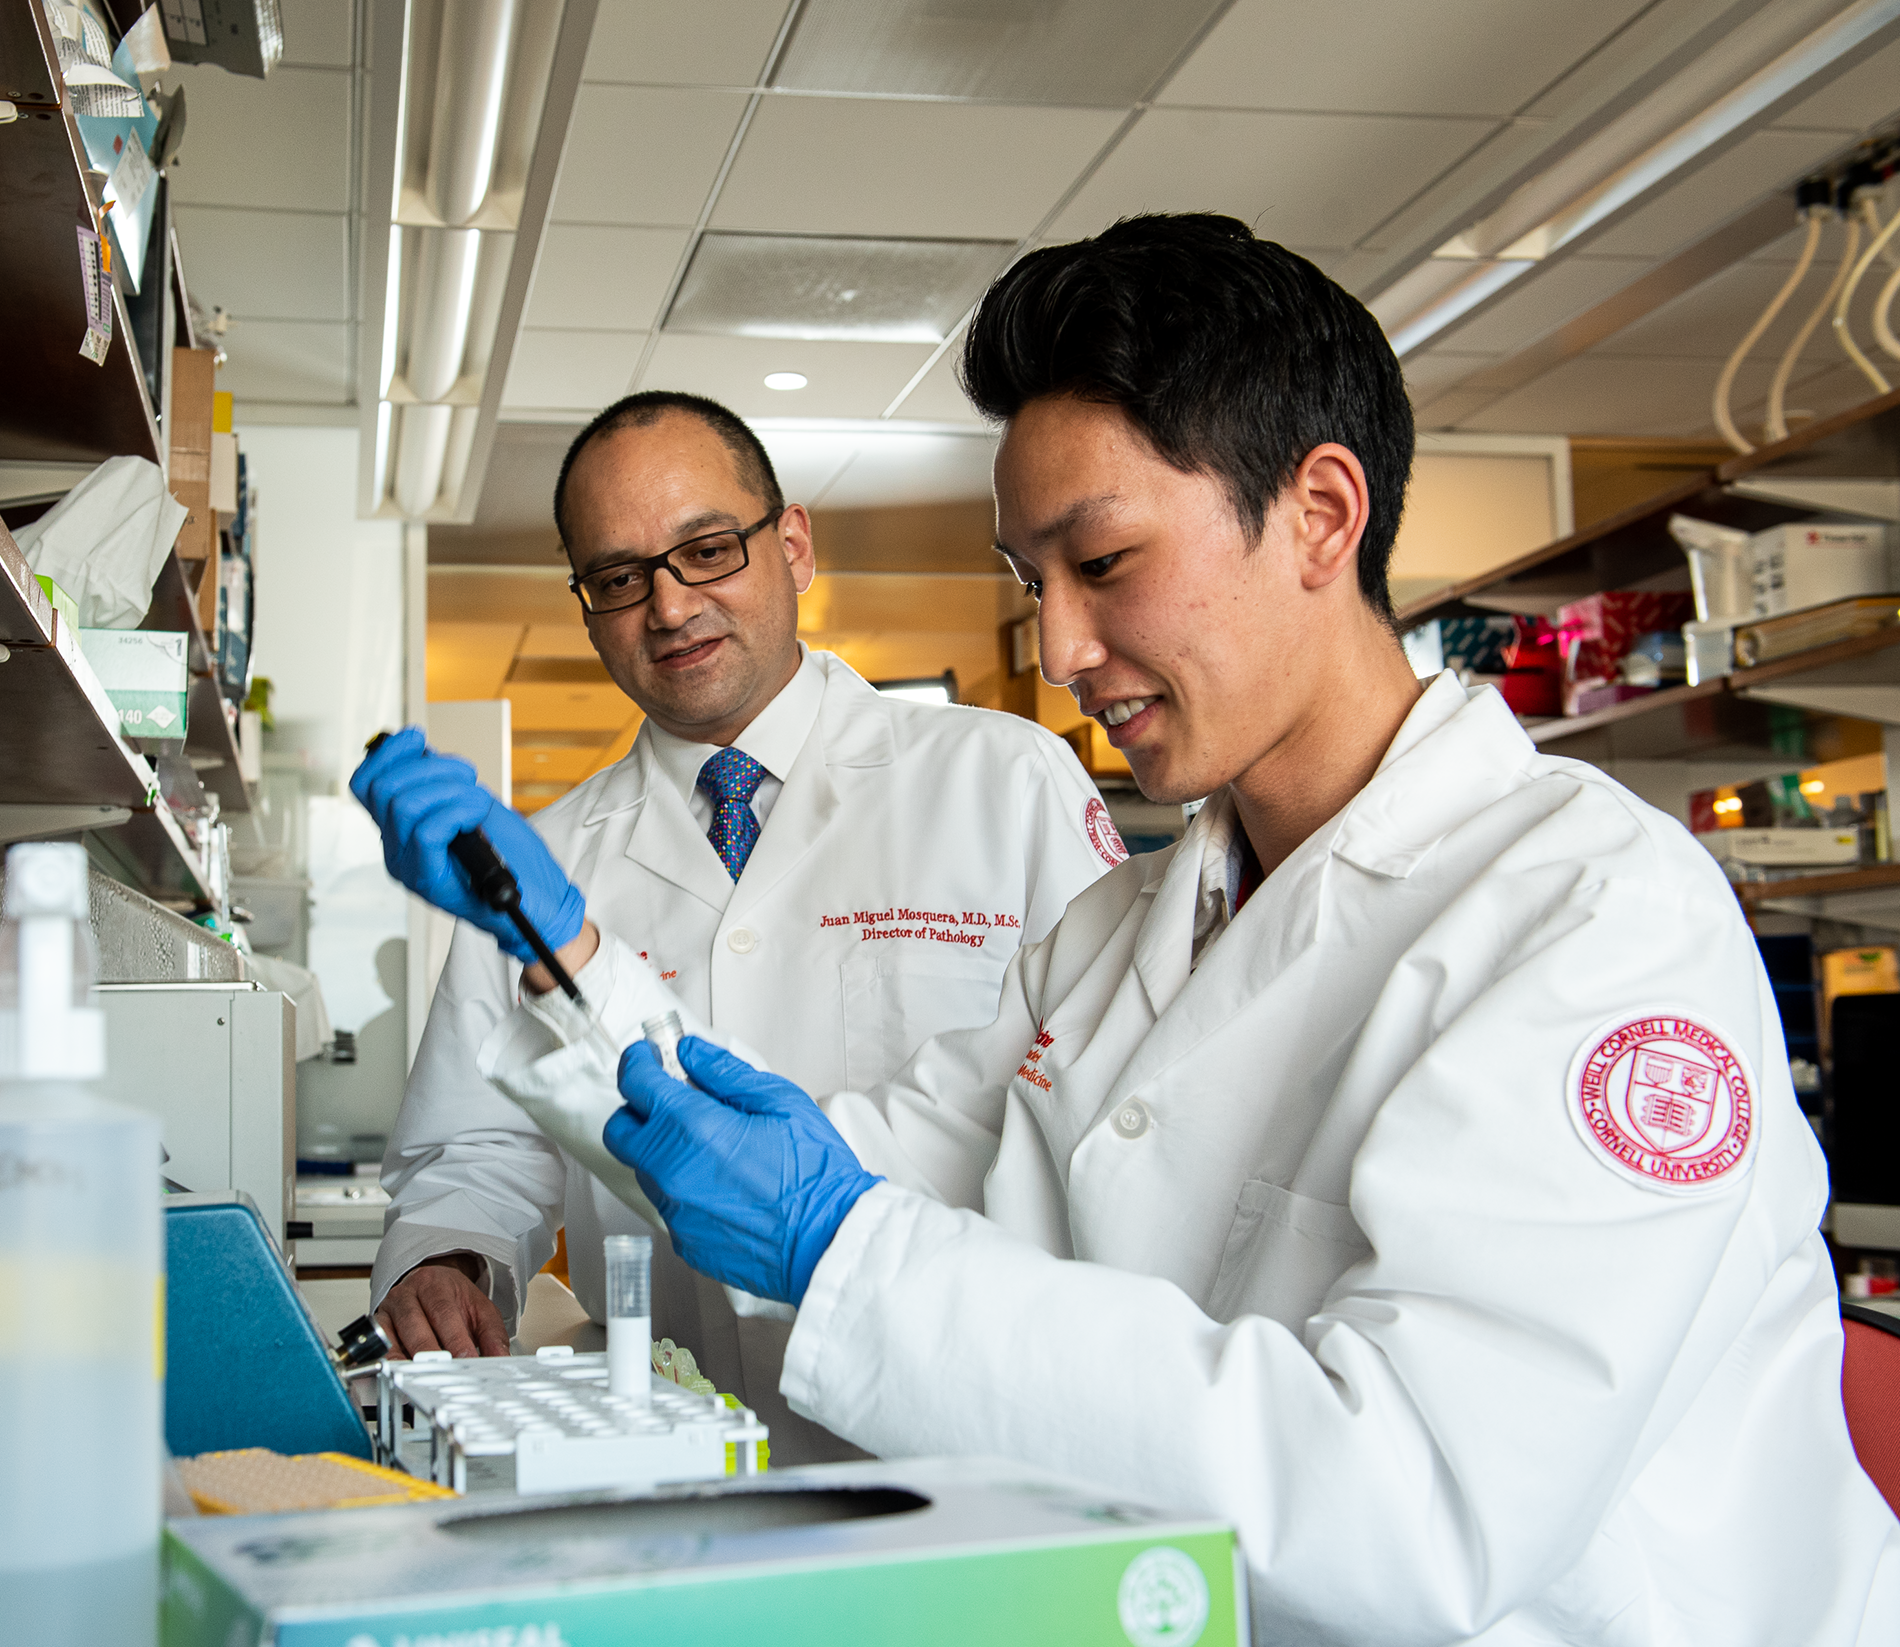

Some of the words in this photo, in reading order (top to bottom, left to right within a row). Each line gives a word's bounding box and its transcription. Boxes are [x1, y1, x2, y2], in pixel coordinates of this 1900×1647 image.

[820, 915, 850, 928] Juan
[853, 908, 895, 926] Miguel
[898, 908, 959, 927] Mosquera,
[961, 911, 992, 928] M.D.,
[861, 928, 914, 941] Director
[914, 926, 927, 939] of
[929, 928, 986, 948] Pathology
[1016, 1063, 1052, 1092] Medicine
[1583, 1061, 1607, 1101] WEILL
[1601, 1020, 1669, 1058] CORNELL
[1674, 1020, 1737, 1074] MEDICAL
[1731, 1075, 1750, 1144] COLLEGE
[1589, 1107, 1645, 1169] CORNELL
[1651, 1144, 1739, 1179] UNIVERSITY
